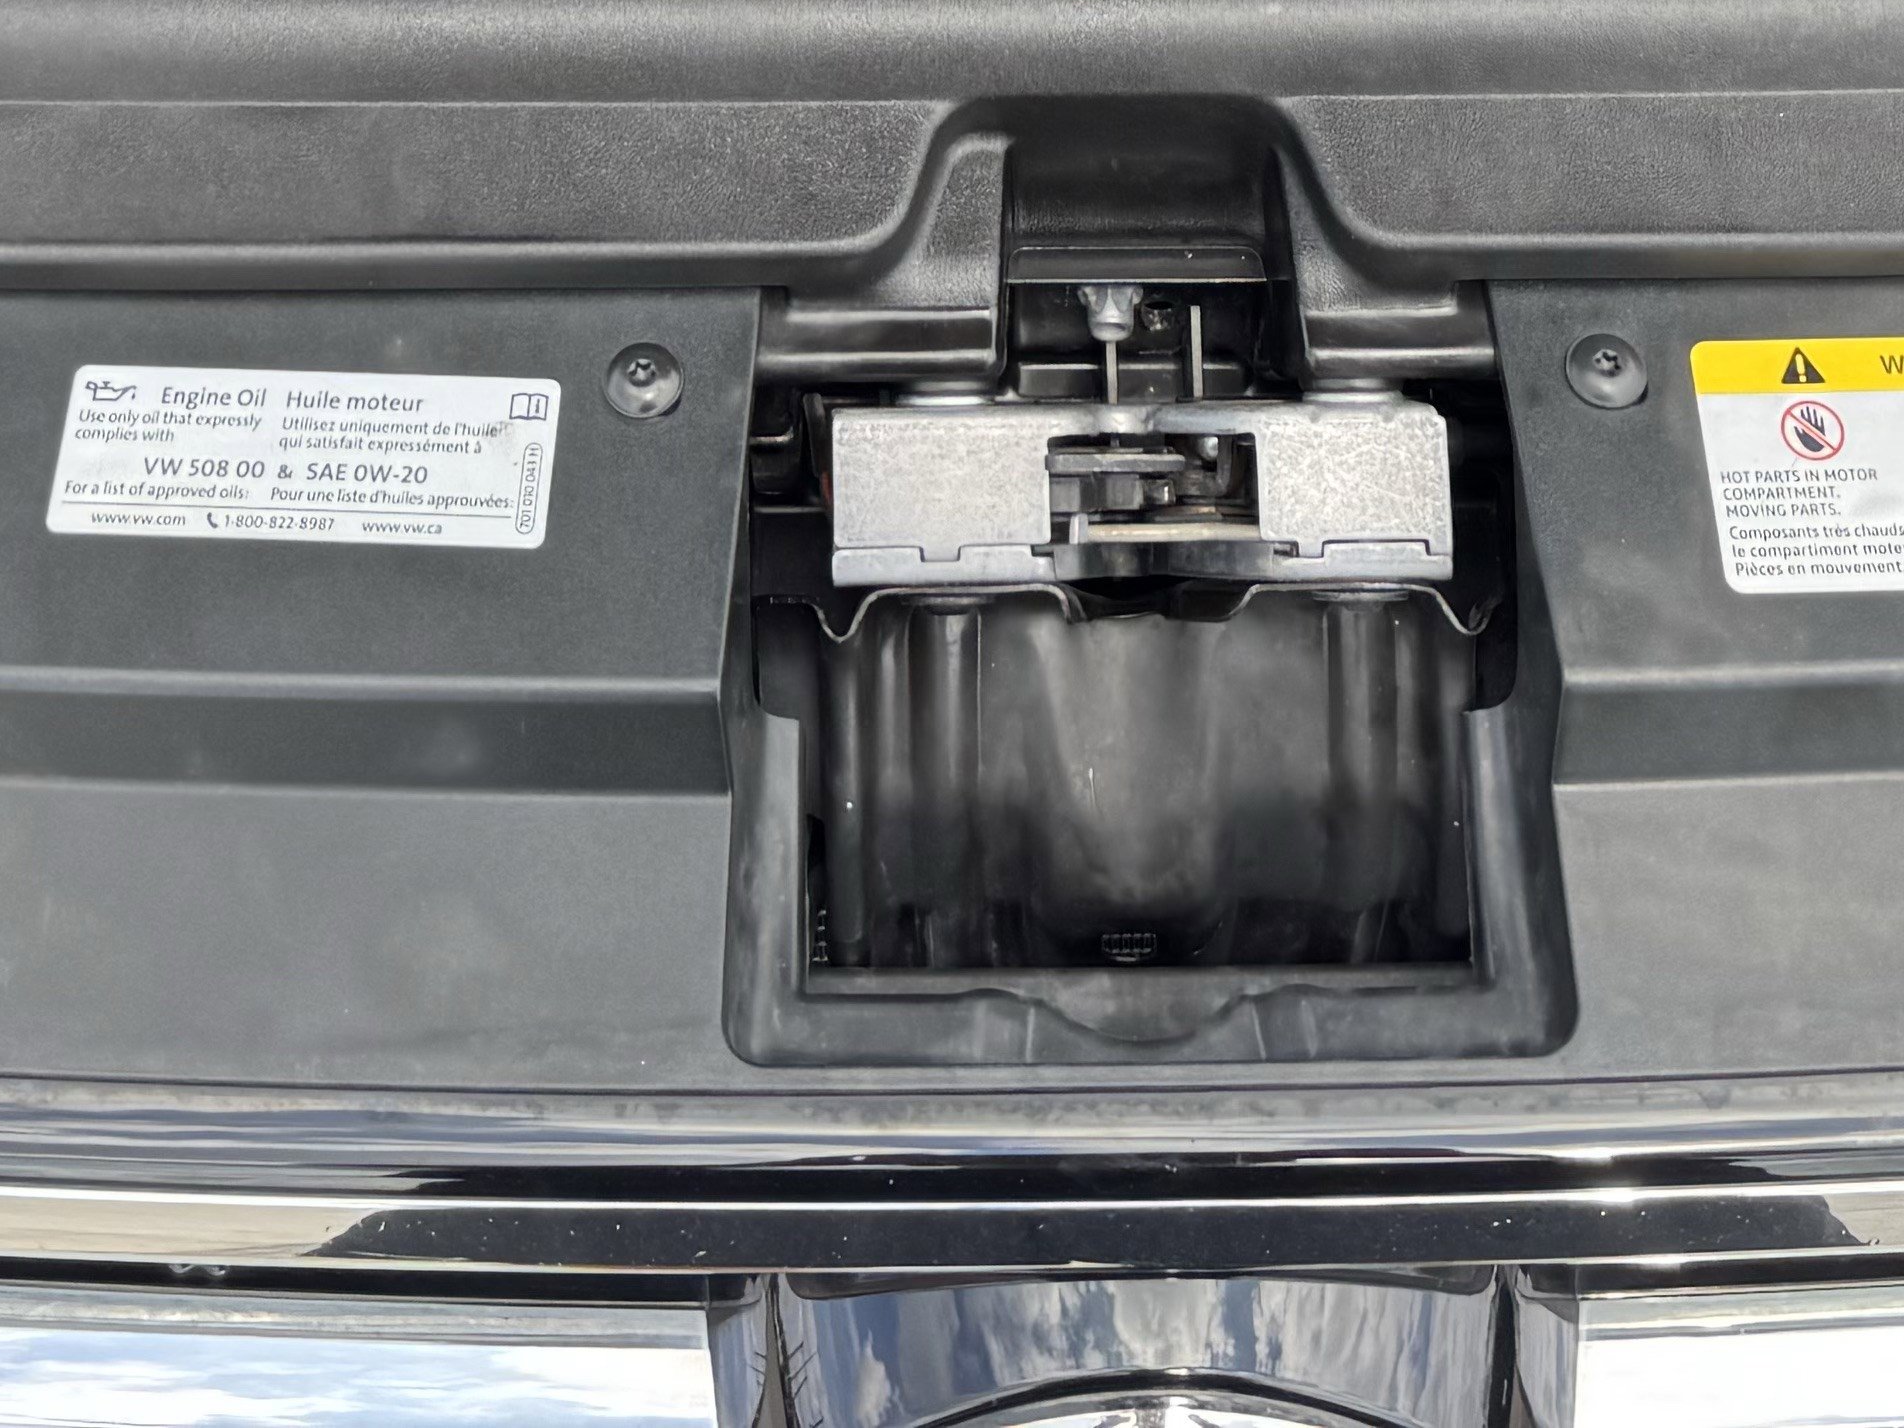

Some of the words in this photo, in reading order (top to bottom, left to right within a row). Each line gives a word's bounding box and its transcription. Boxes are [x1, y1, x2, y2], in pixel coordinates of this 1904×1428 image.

[161, 386, 231, 410] Engine
[238, 388, 267, 407] Oil
[286, 391, 341, 410] Huile
[347, 395, 424, 412] moteur
[79, 409, 106, 423] Use
[108, 410, 139, 427] only
[142, 410, 159, 423] oil
[163, 412, 192, 426] that
[195, 414, 262, 432] expressly
[282, 416, 336, 431] Utilisez
[339, 420, 429, 438] uniquement
[432, 423, 451, 436] de
[454, 423, 498, 438] l'huile
[75, 427, 138, 443] complies
[142, 429, 174, 442] with
[279, 435, 303, 453] qui
[306, 436, 364, 450] satisfait
[368, 438, 470, 455] expressément
[144, 457, 184, 476] VW
[188, 459, 229, 478] 508
[236, 460, 265, 478] 00
[278, 464, 292, 479] &
[307, 462, 346, 481] SAE
[354, 464, 428, 484] 0W-20
[1720, 471, 1751, 484] HOT
[1755, 469, 1801, 482] PARTS
[1804, 469, 1820, 482] IN
[1824, 468, 1878, 482] MOTOR
[65, 480, 88, 494] For
[91, 484, 99, 495] a
[103, 481, 124, 495] list
[129, 481, 146, 496] of
[147, 484, 216, 501] approved
[270, 487, 304, 502] Pour
[307, 490, 334, 502] une
[337, 488, 367, 503] liste
[369, 489, 424, 505] d'huiles
[1723, 486, 1842, 501] COMPARTMENT.
[1726, 503, 1787, 518] MOVING
[1791, 502, 1842, 517] PARTS.
[91, 512, 187, 526] www.vw.com
[225, 513, 335, 531] 1-800-822-8987
[362, 519, 443, 535] www.vw.ca
[1729, 524, 1820, 542] Composants
[1823, 523, 1851, 537] très
[1732, 545, 1746, 558] le
[1750, 544, 1858, 561] compartiment
[1735, 561, 1784, 577] Pièces
[1787, 564, 1806, 575] en
